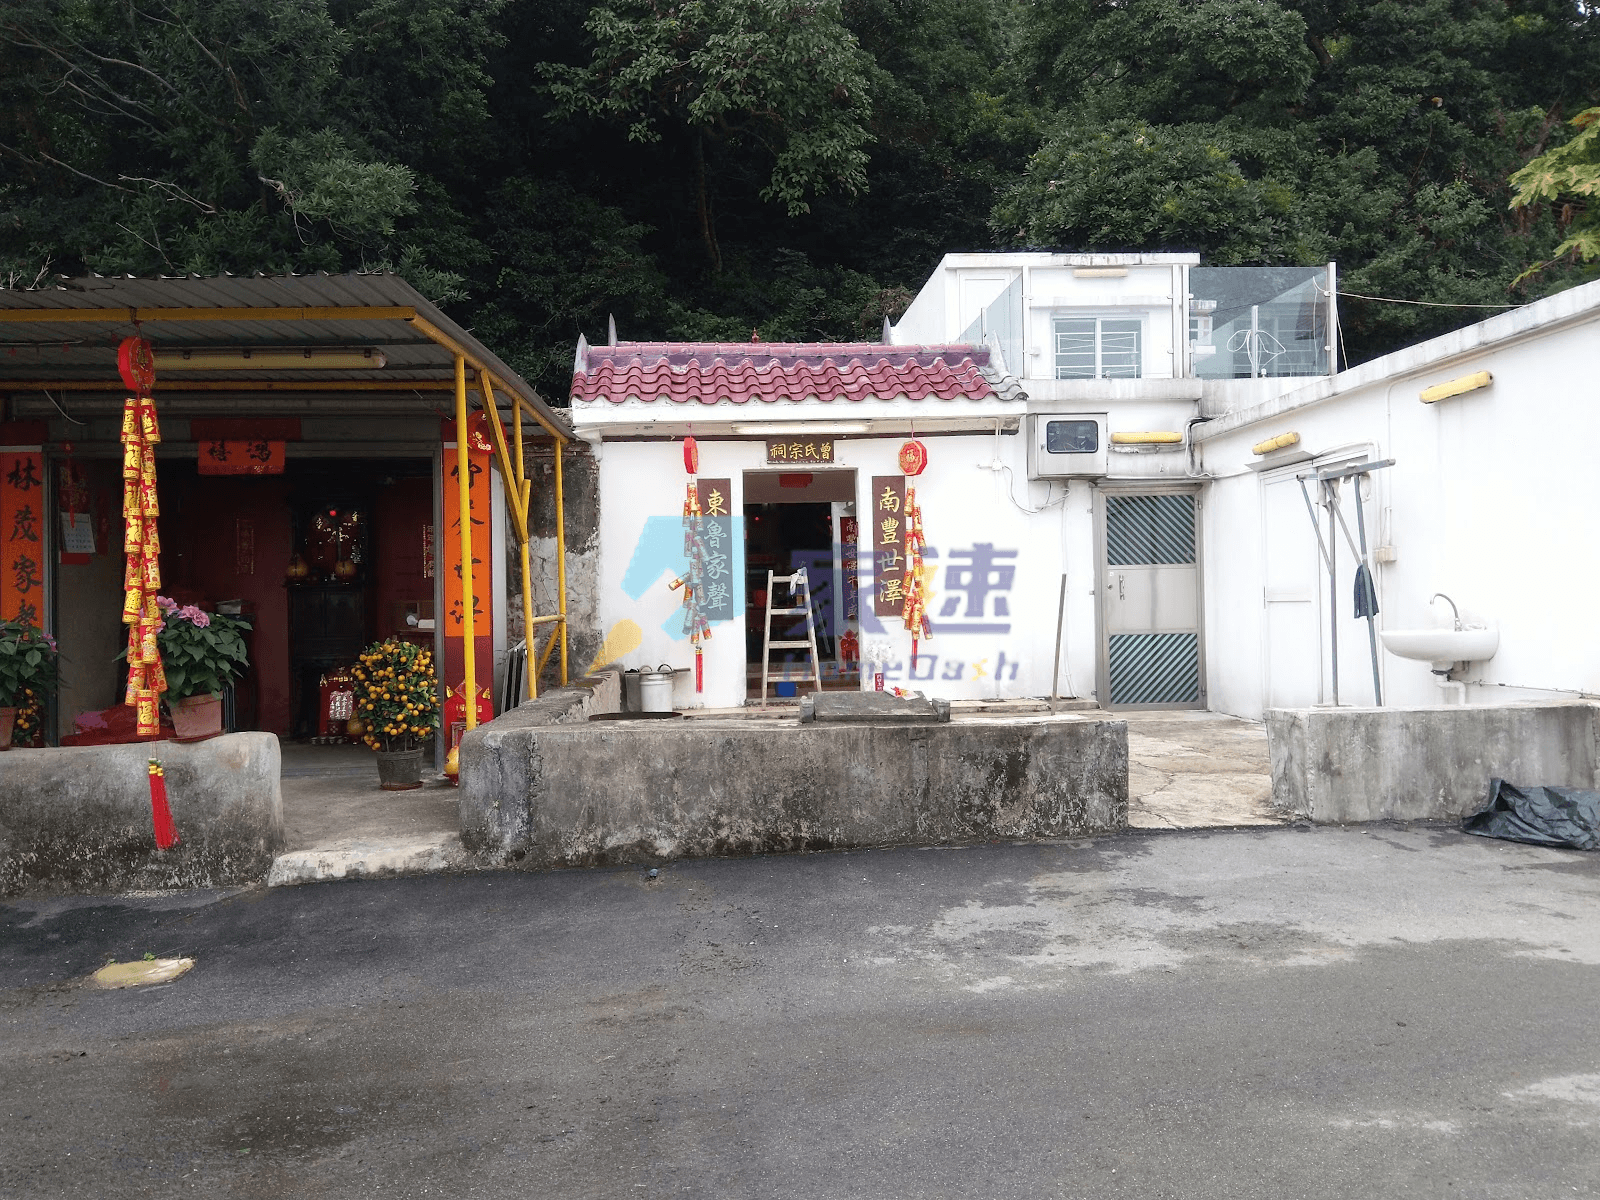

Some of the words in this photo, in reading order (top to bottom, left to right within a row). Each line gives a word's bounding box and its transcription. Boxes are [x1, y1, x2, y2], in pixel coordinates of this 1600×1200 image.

[704, 488, 729, 611] 東魯家聲
[877, 486, 904, 606] 南豐世澤
